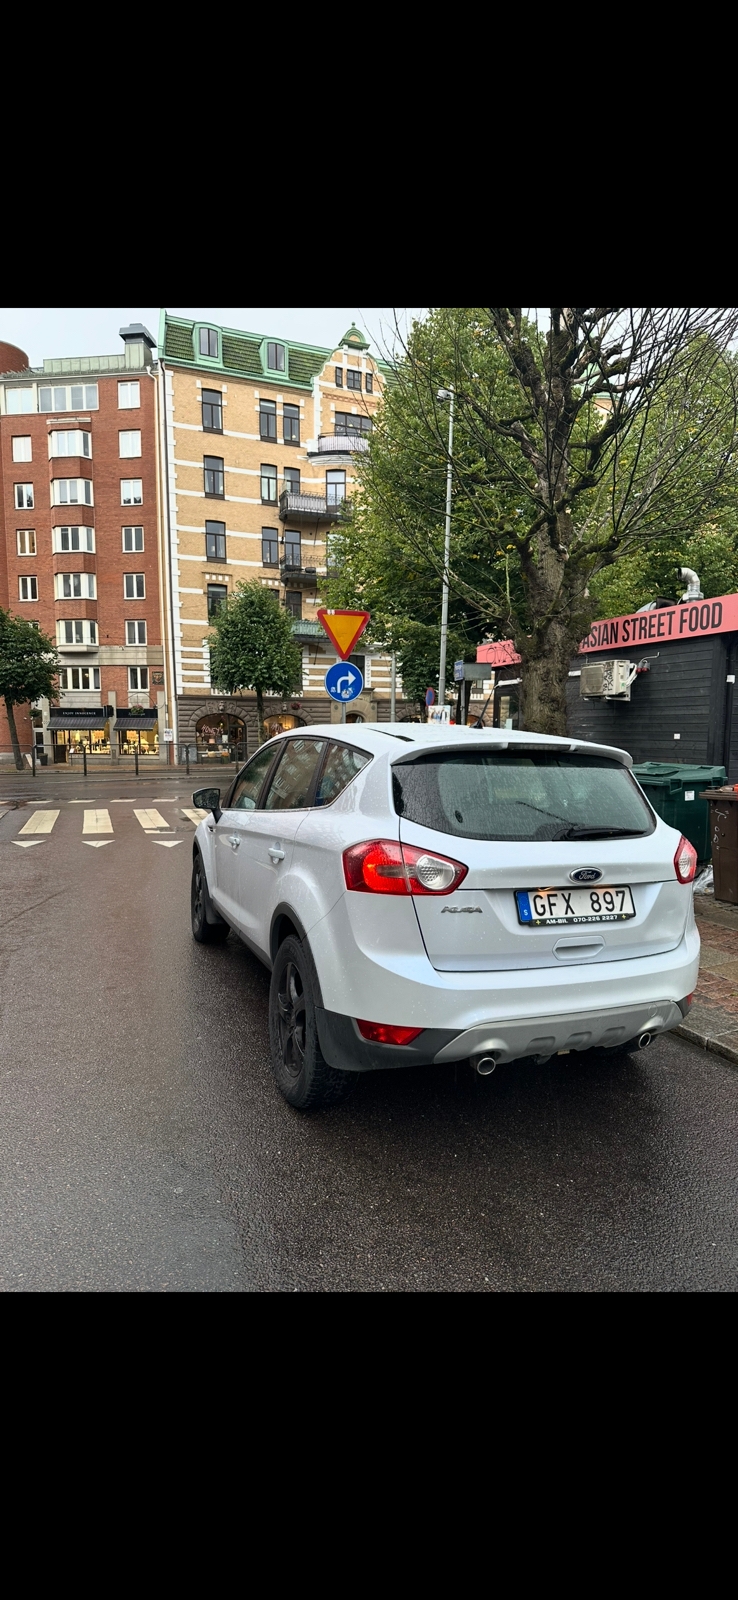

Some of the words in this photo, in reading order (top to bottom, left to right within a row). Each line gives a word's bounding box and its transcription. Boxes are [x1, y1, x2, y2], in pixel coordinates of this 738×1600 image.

[582, 622, 619, 649] ASIAN
[622, 610, 676, 643] STREET
[679, 601, 723, 634] FOOD
[578, 870, 597, 880] Ford
[533, 892, 575, 916] GFX
[589, 890, 626, 913] 897
